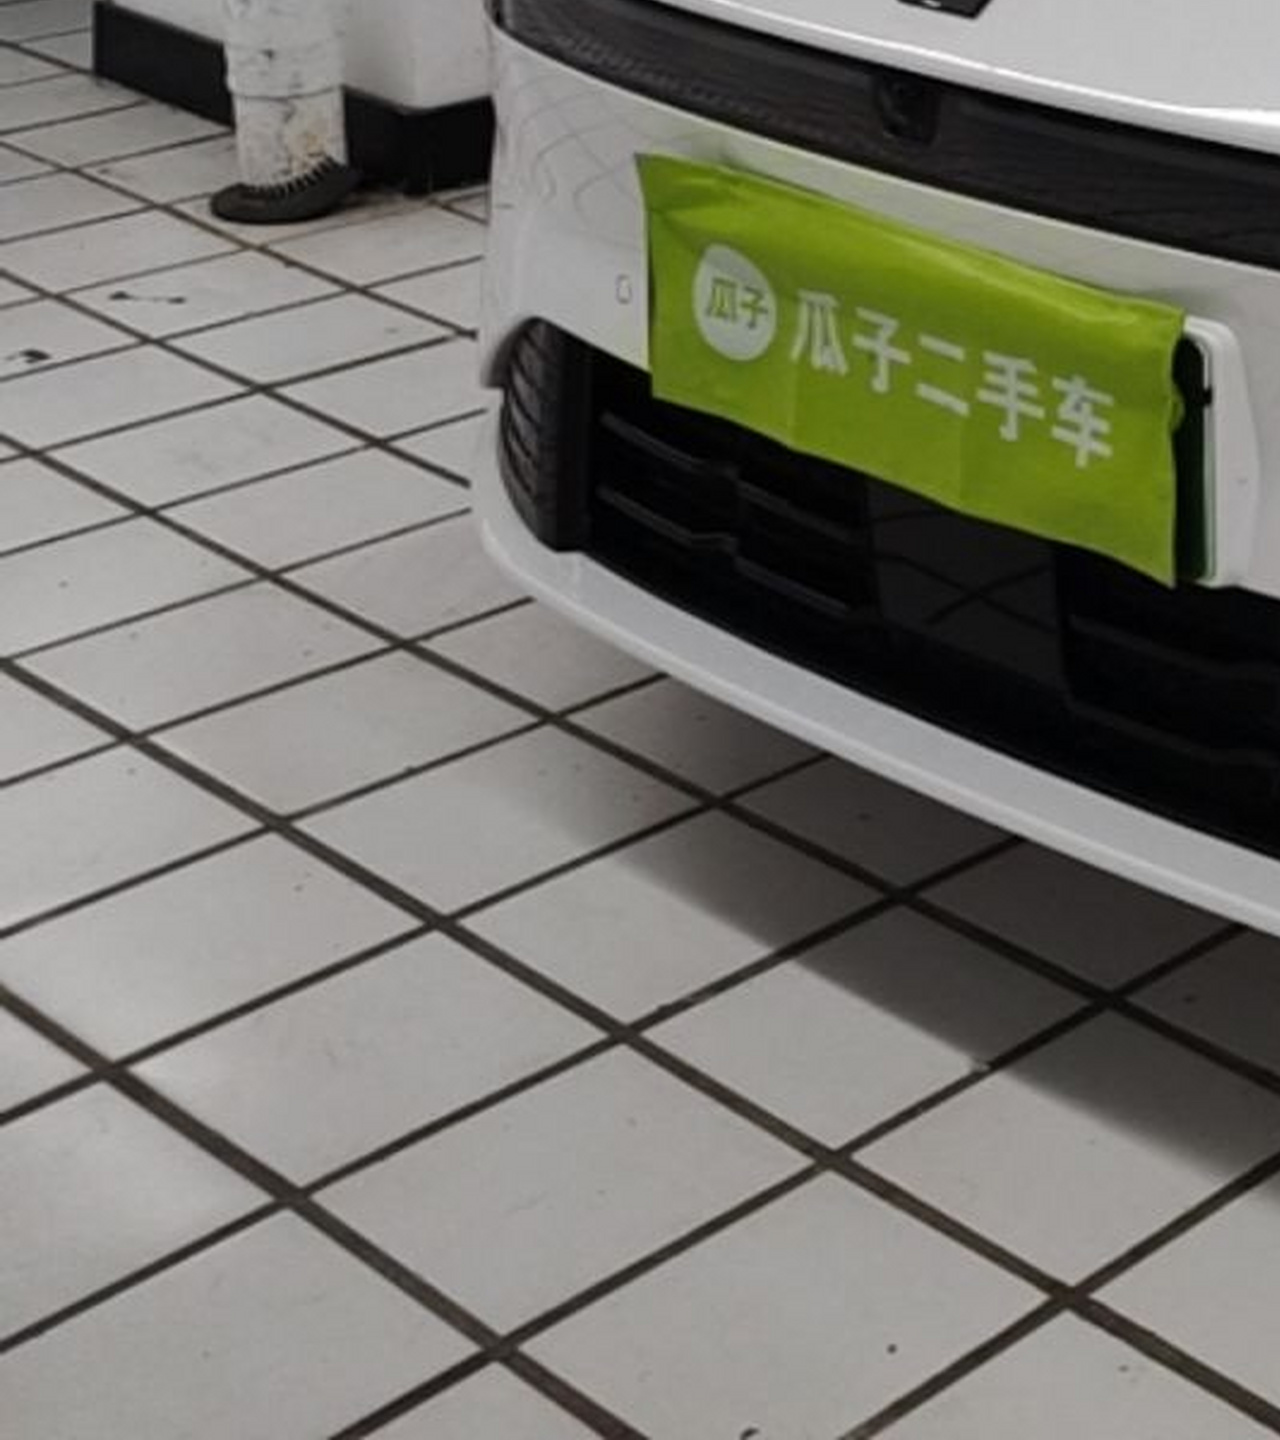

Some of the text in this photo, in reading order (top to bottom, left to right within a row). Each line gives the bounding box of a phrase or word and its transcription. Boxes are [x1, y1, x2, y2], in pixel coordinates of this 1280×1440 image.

[706, 276, 769, 329] 瓜子
[790, 290, 1115, 467] 瓜子二手车
